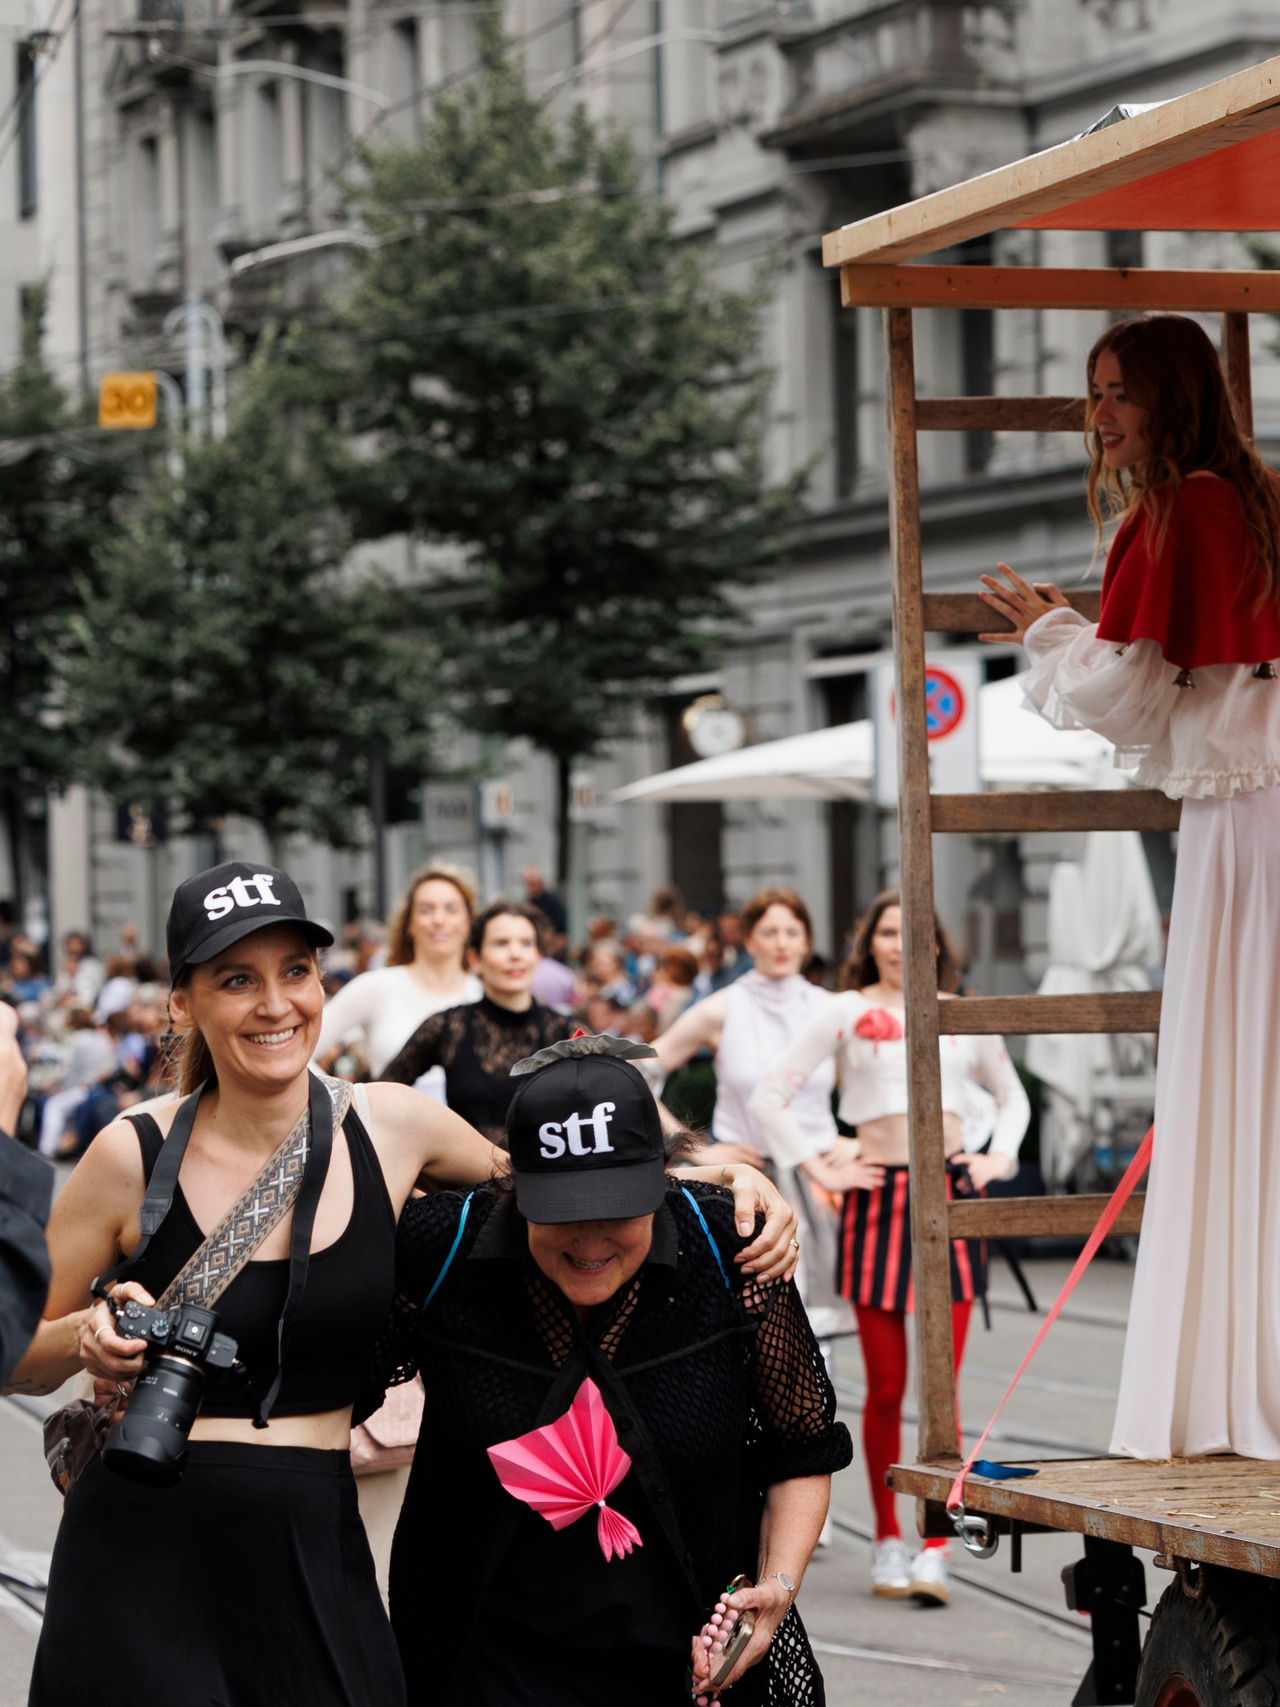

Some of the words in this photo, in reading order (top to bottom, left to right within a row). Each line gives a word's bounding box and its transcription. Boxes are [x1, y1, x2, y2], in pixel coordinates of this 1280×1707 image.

[203, 873, 282, 921] stf
[538, 1101, 616, 1159] stf
[174, 1344, 199, 1357] SONY
